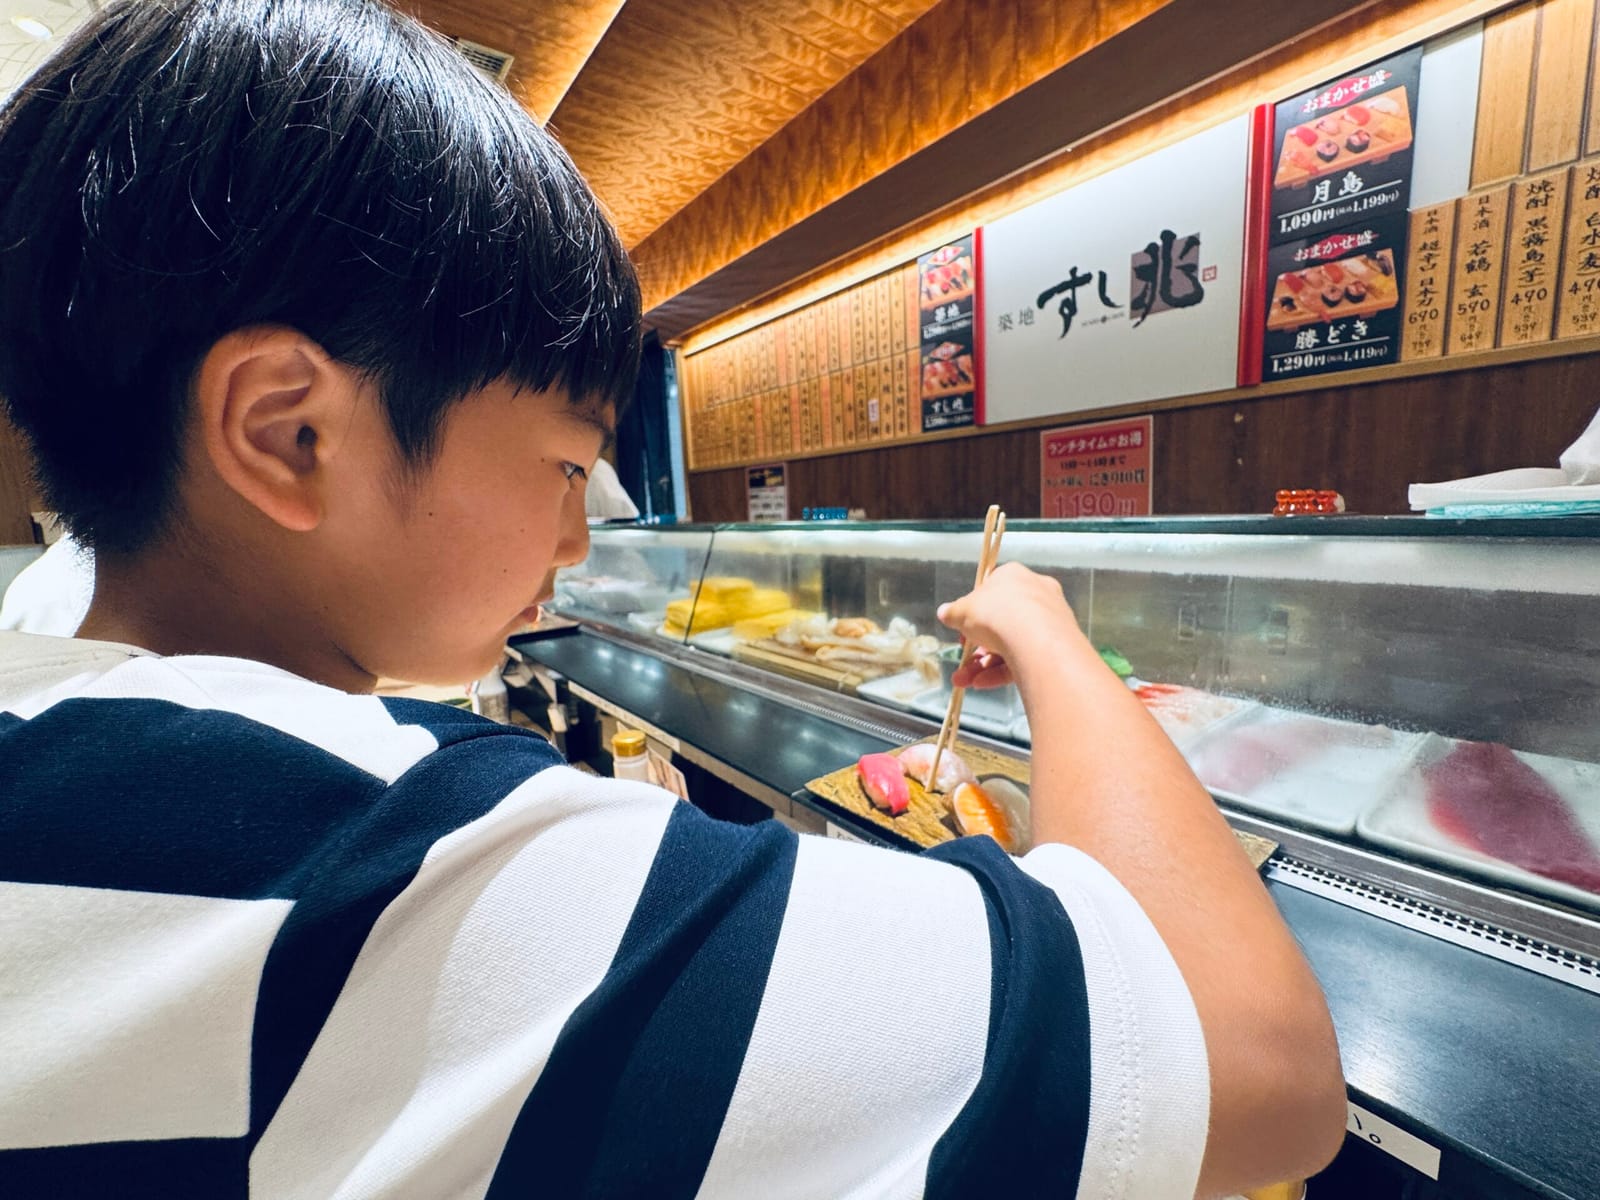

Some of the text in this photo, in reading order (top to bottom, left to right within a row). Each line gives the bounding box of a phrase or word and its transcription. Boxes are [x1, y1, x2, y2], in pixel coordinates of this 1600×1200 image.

[1303, 70, 1387, 113] おまかせ盛
[1312, 171, 1364, 203] 月島
[1526, 180, 1555, 210] 焼酎
[1473, 195, 1492, 231] 日本酒
[1294, 230, 1374, 261] おまかせ盛
[999, 307, 1035, 332] 築地
[1408, 308, 1439, 325] 690
[1458, 298, 1490, 316] 590
[1295, 319, 1368, 349] 勝どき
